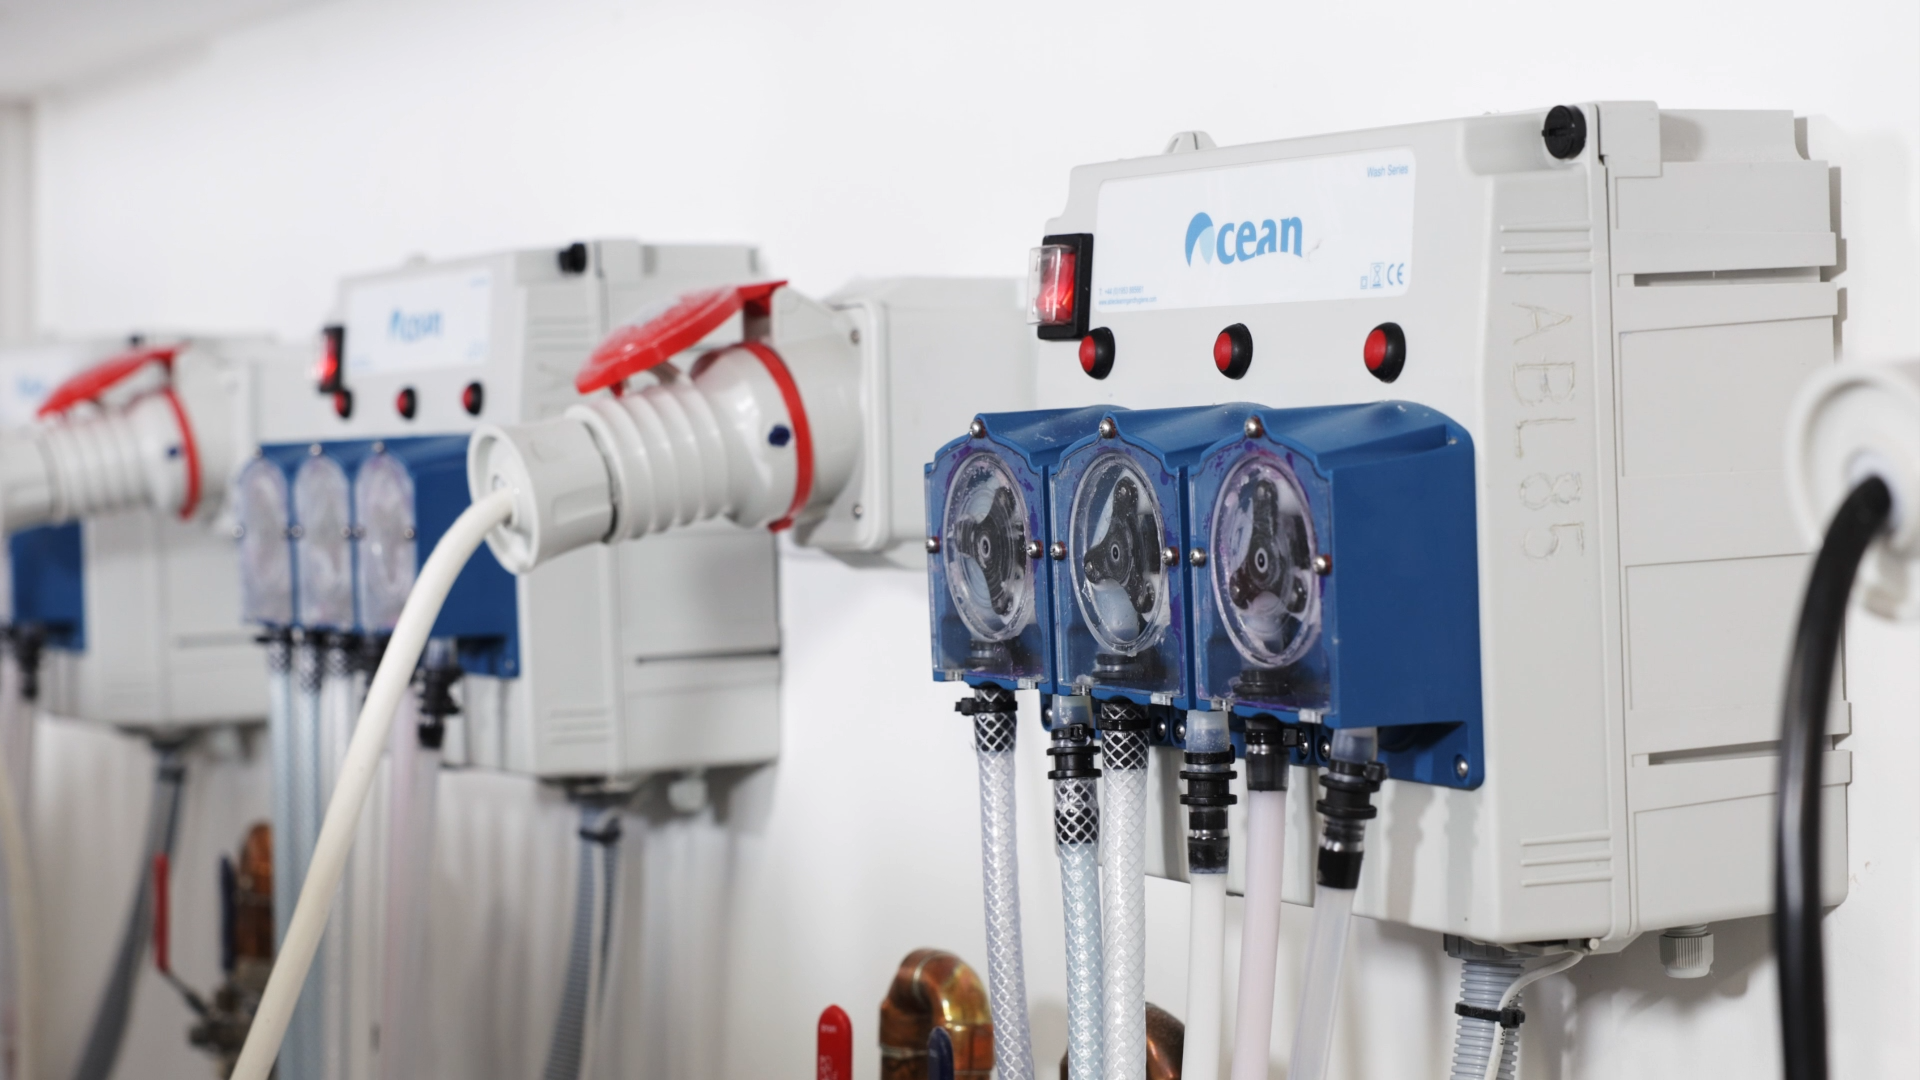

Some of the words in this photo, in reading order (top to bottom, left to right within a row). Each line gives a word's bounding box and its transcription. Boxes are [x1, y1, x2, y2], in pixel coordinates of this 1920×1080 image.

[1367, 166, 1385, 177] Wash
[1387, 164, 1408, 176] Series
[1185, 212, 1303, 267] Ocean
[1512, 302, 1584, 559] ABL85
